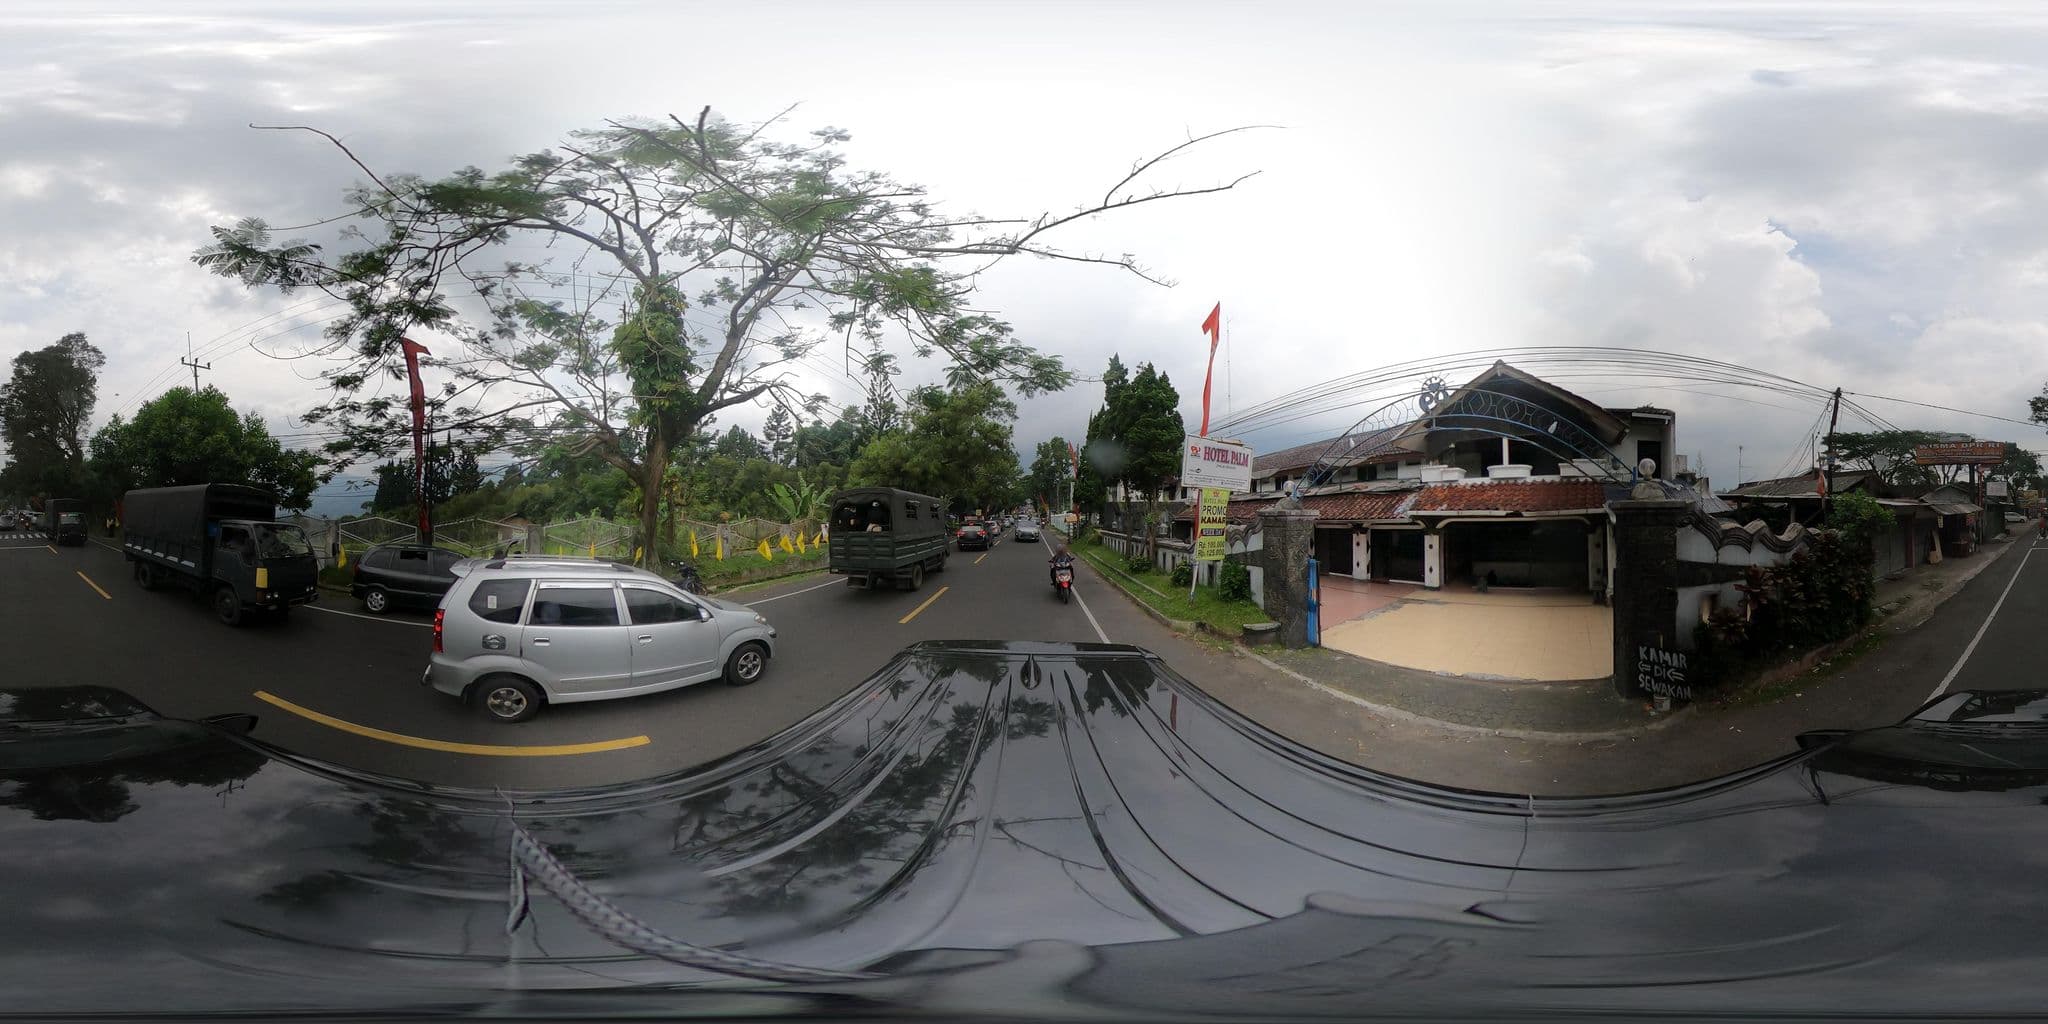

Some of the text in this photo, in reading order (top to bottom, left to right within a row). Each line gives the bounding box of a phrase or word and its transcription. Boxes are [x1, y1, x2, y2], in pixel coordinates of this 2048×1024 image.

[1203, 446, 1249, 467] HOTEL PALM
[1639, 646, 1688, 670] KAMAR
[1638, 673, 1691, 699] SEWAKAN
